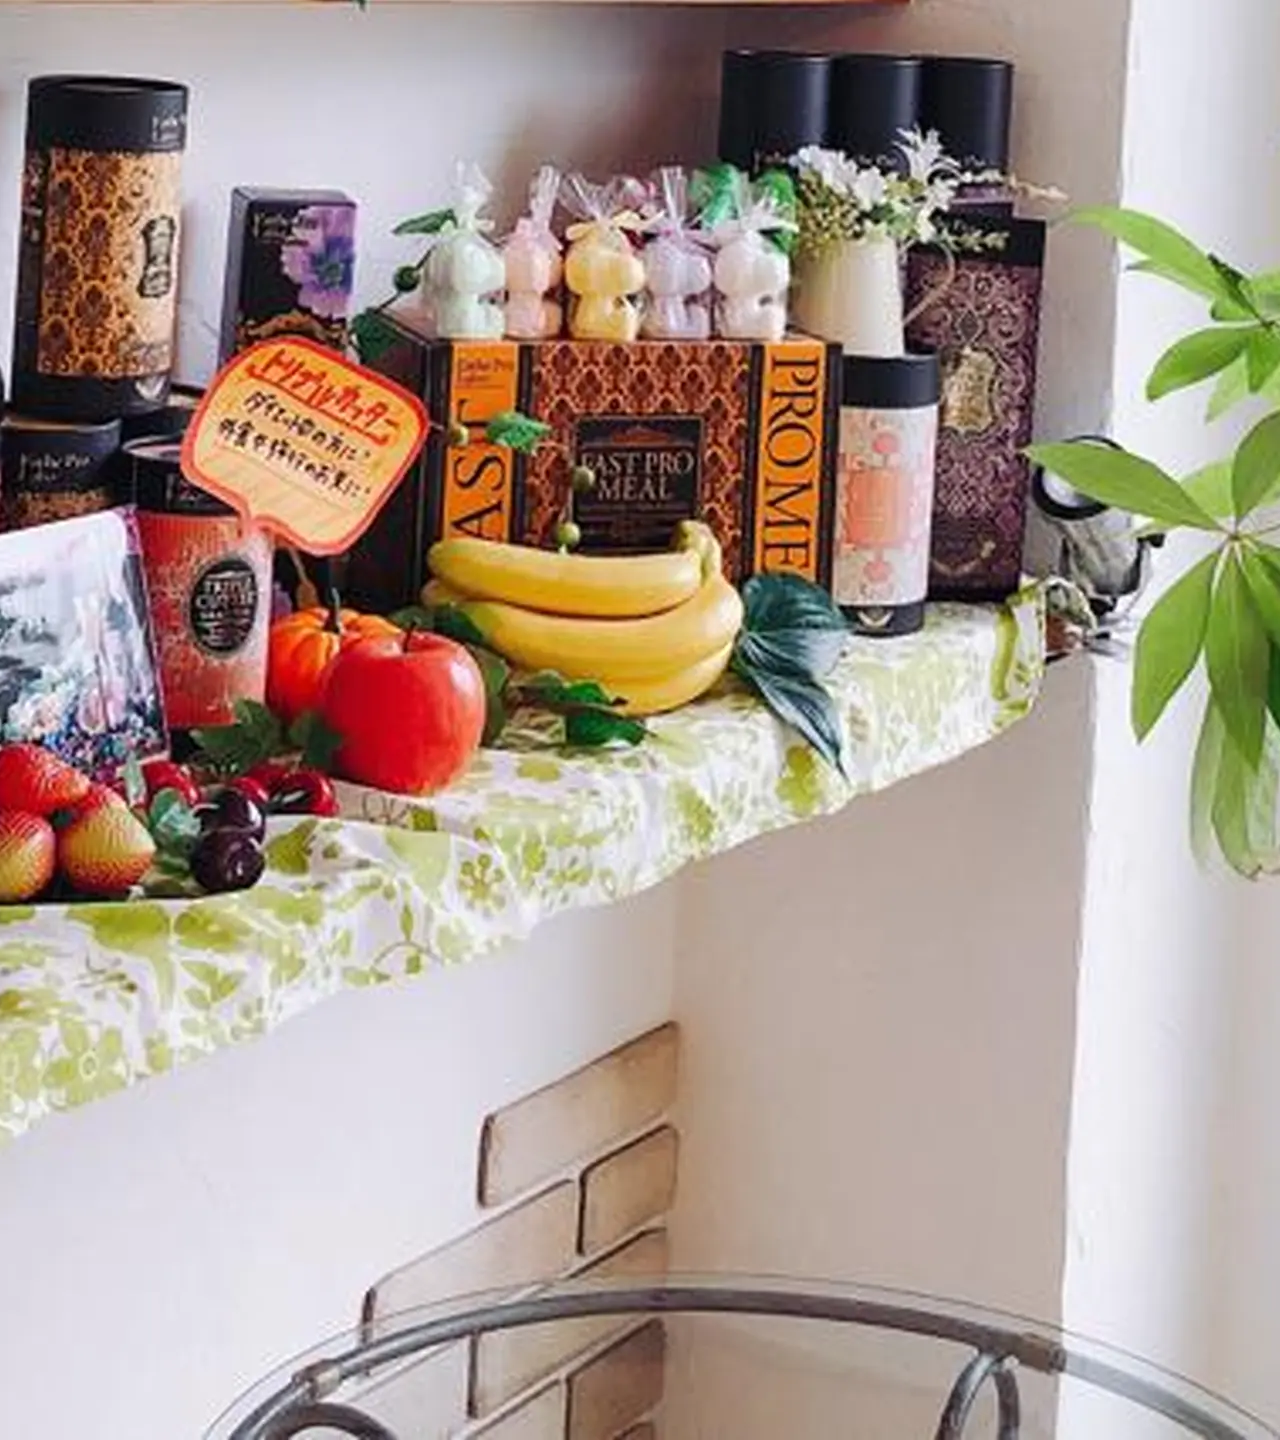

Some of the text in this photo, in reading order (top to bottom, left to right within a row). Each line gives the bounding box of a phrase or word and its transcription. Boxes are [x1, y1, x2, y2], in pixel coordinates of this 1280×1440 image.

[448, 398, 507, 541] AST
[597, 476, 675, 501] MEAL
[644, 449, 694, 475] PRO
[761, 355, 822, 572] PRO ME
